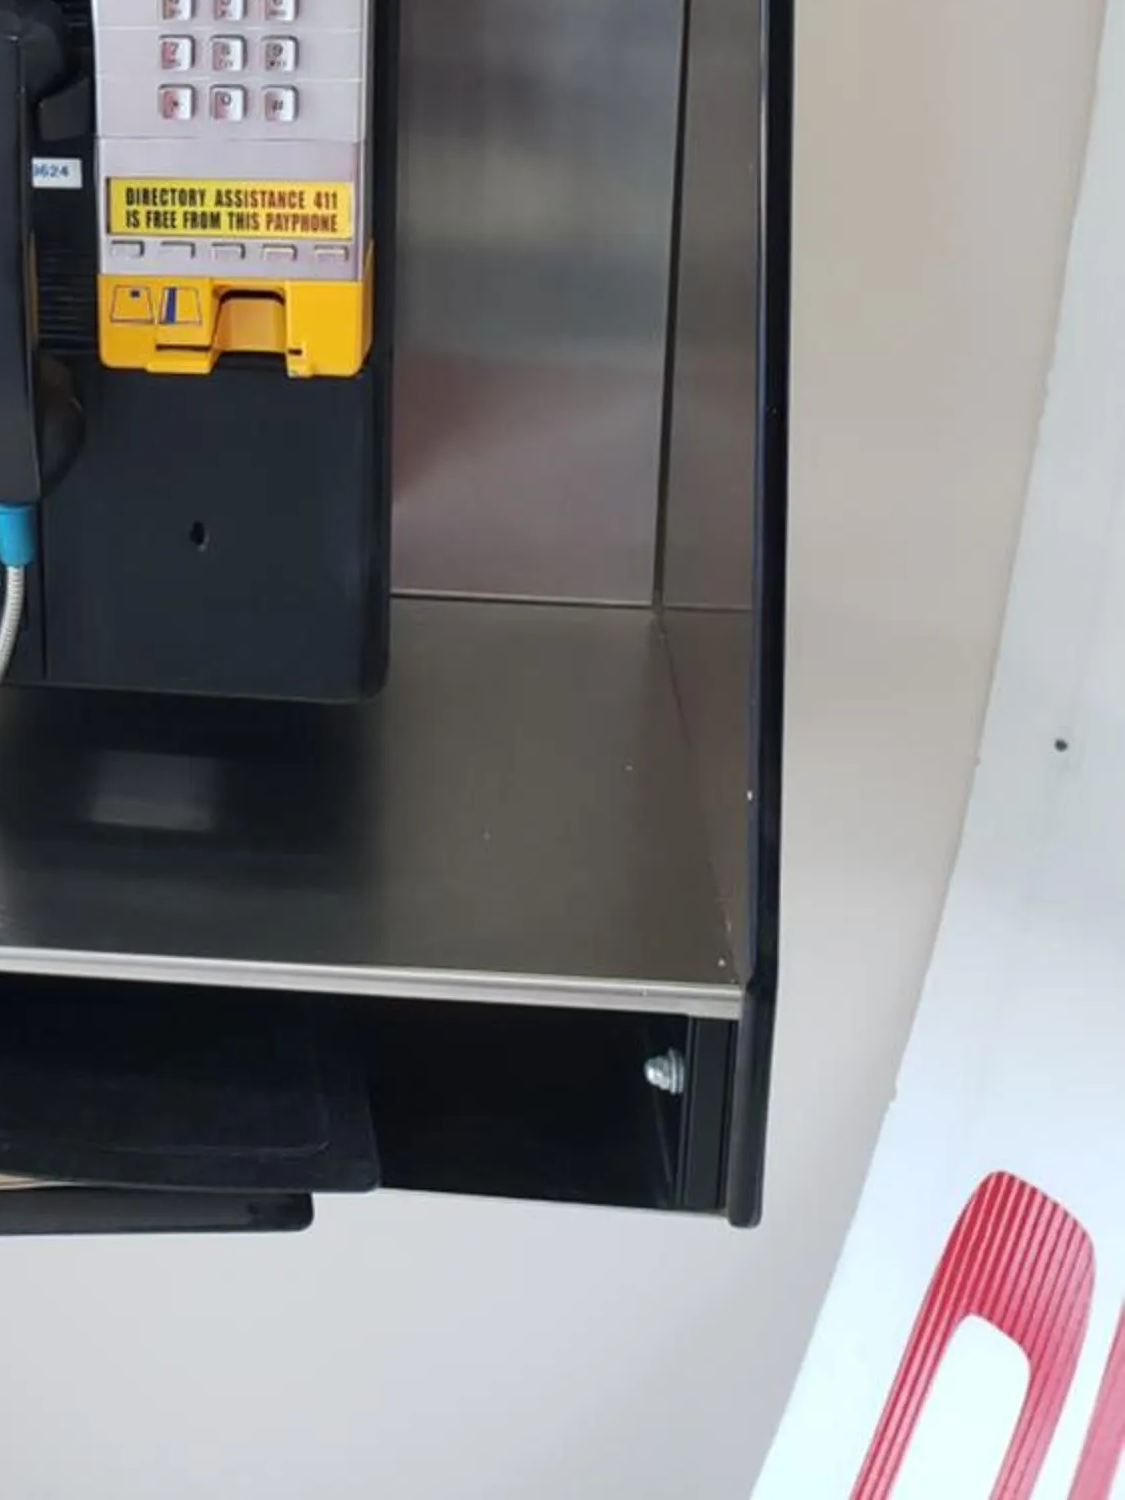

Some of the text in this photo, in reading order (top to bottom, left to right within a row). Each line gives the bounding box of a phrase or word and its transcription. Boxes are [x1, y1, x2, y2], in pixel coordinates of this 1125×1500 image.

[125, 188, 338, 210] DIRECTORY ASSISTANCE 411
[125, 210, 338, 232] IS FREE FROM THIS PAYPHONE
